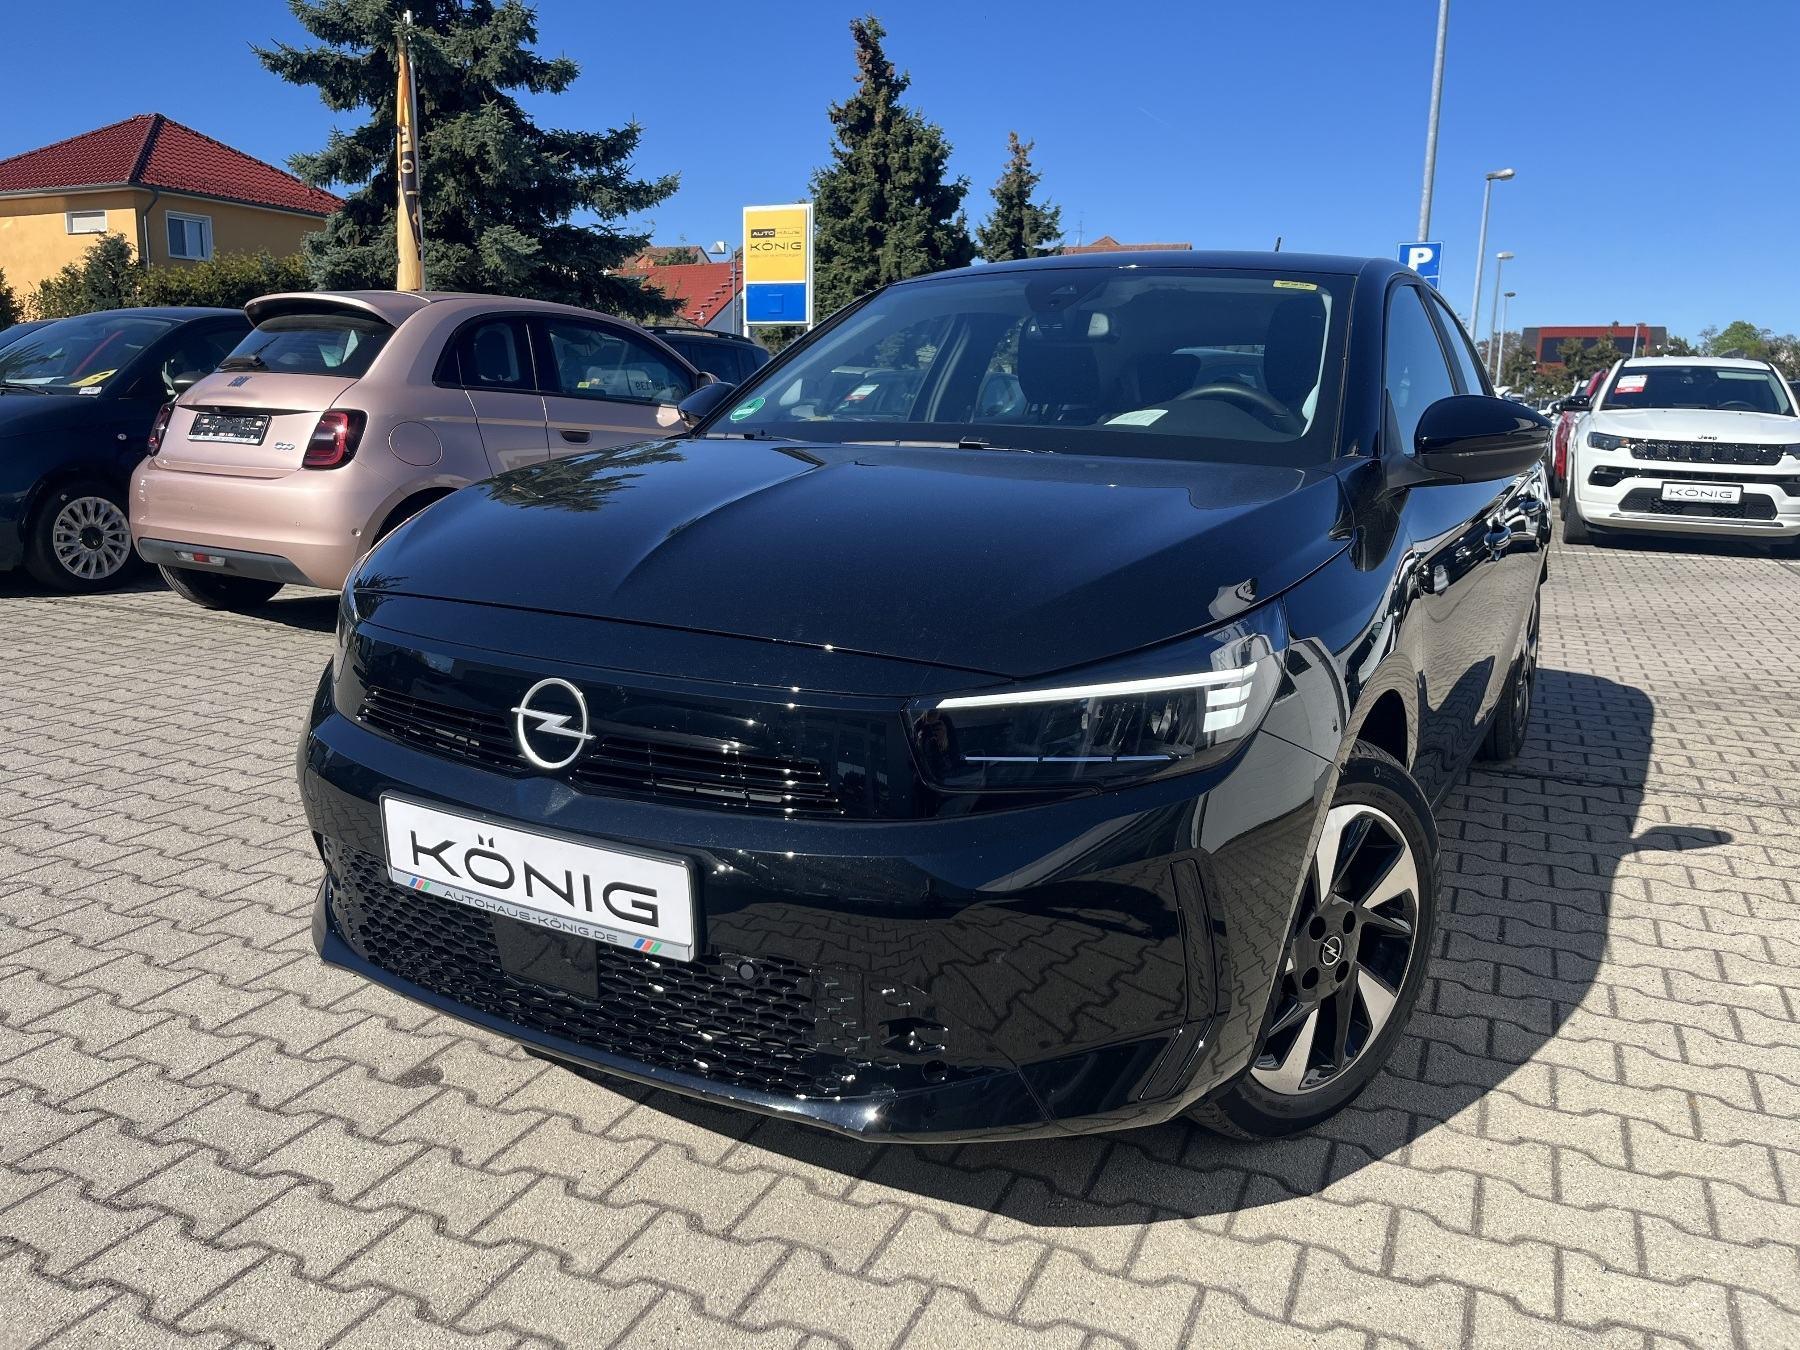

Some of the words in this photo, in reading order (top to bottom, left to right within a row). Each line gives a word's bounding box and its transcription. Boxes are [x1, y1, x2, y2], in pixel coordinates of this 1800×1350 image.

[750, 240, 802, 251] KÖNIG
[1407, 247, 1433, 271] P
[1669, 486, 1733, 499] KÖNIG
[409, 829, 660, 928] KÖNIG
[443, 889, 619, 944] AUTOHAUS-KÖNIG.DE
